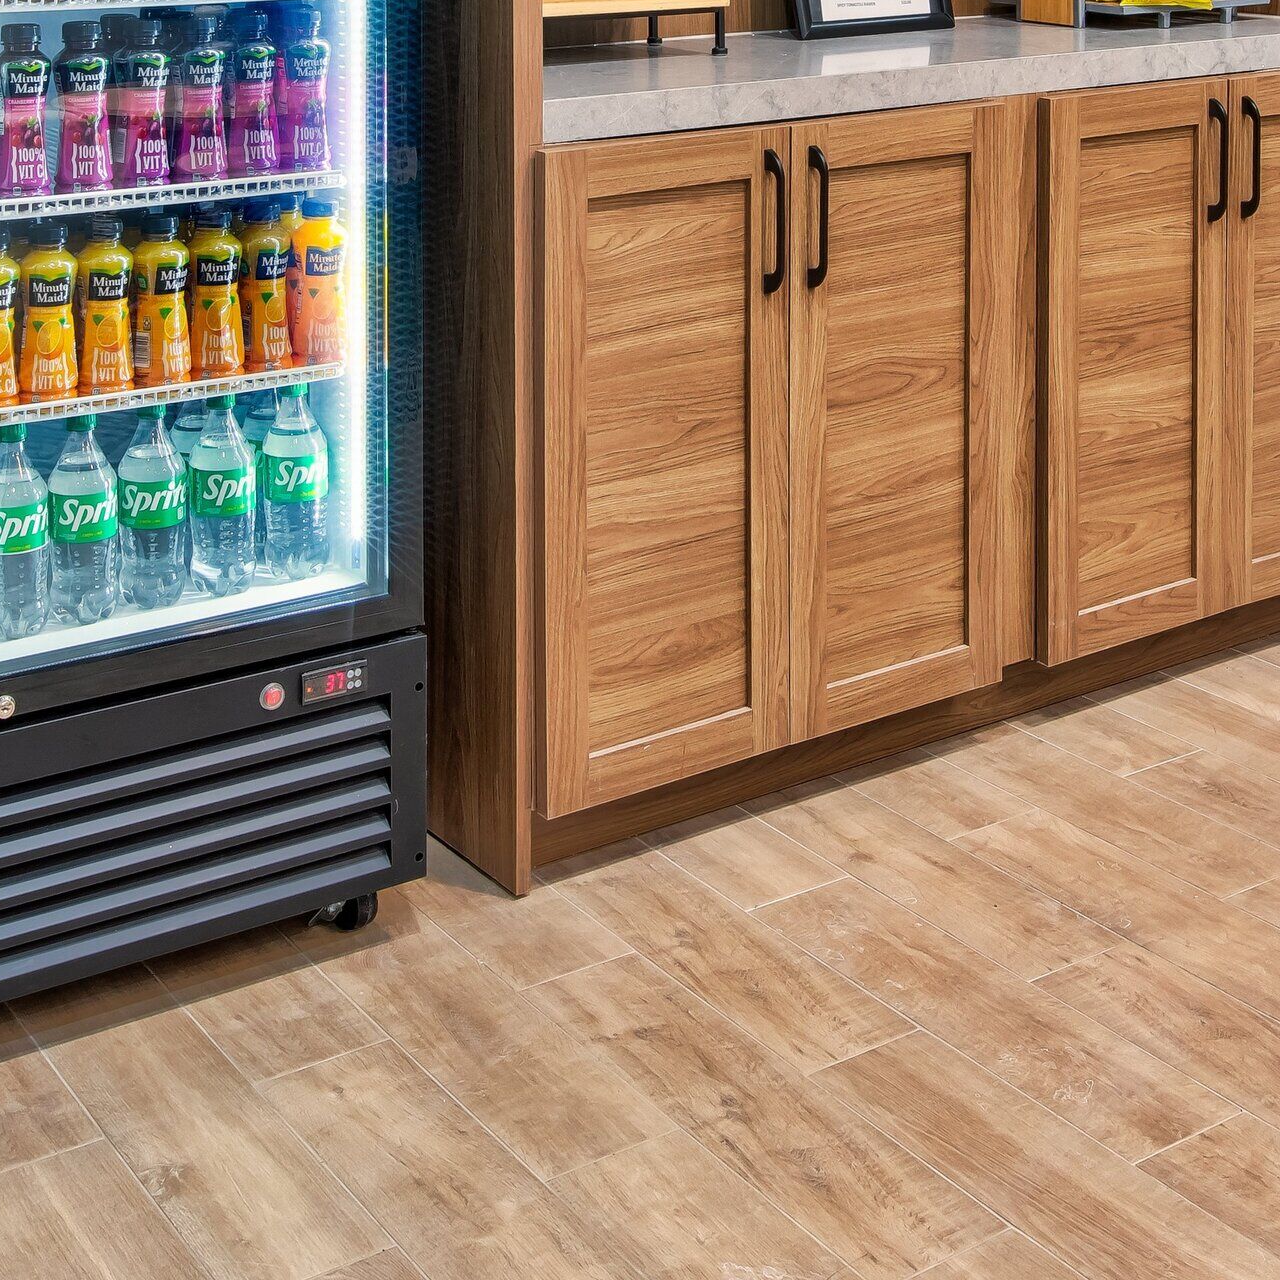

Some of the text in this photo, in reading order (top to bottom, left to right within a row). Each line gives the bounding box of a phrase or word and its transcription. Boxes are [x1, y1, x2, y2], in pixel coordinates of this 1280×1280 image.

[10, 72, 48, 83] Minute
[18, 147, 43, 162] 100%
[250, 146, 265, 160] VIT
[300, 143, 314, 156] VIT
[142, 156, 160, 171] VIT
[196, 152, 212, 166] VIT
[18, 164, 35, 180] VIT
[78, 161, 94, 176] VIT
[32, 282, 69, 292] Minute
[39, 358, 63, 371] 100%
[99, 368, 116, 381] VIT
[38, 375, 54, 389] VIT
[121, 481, 186, 518] Sprite
[325, 671, 346, 694] 37
